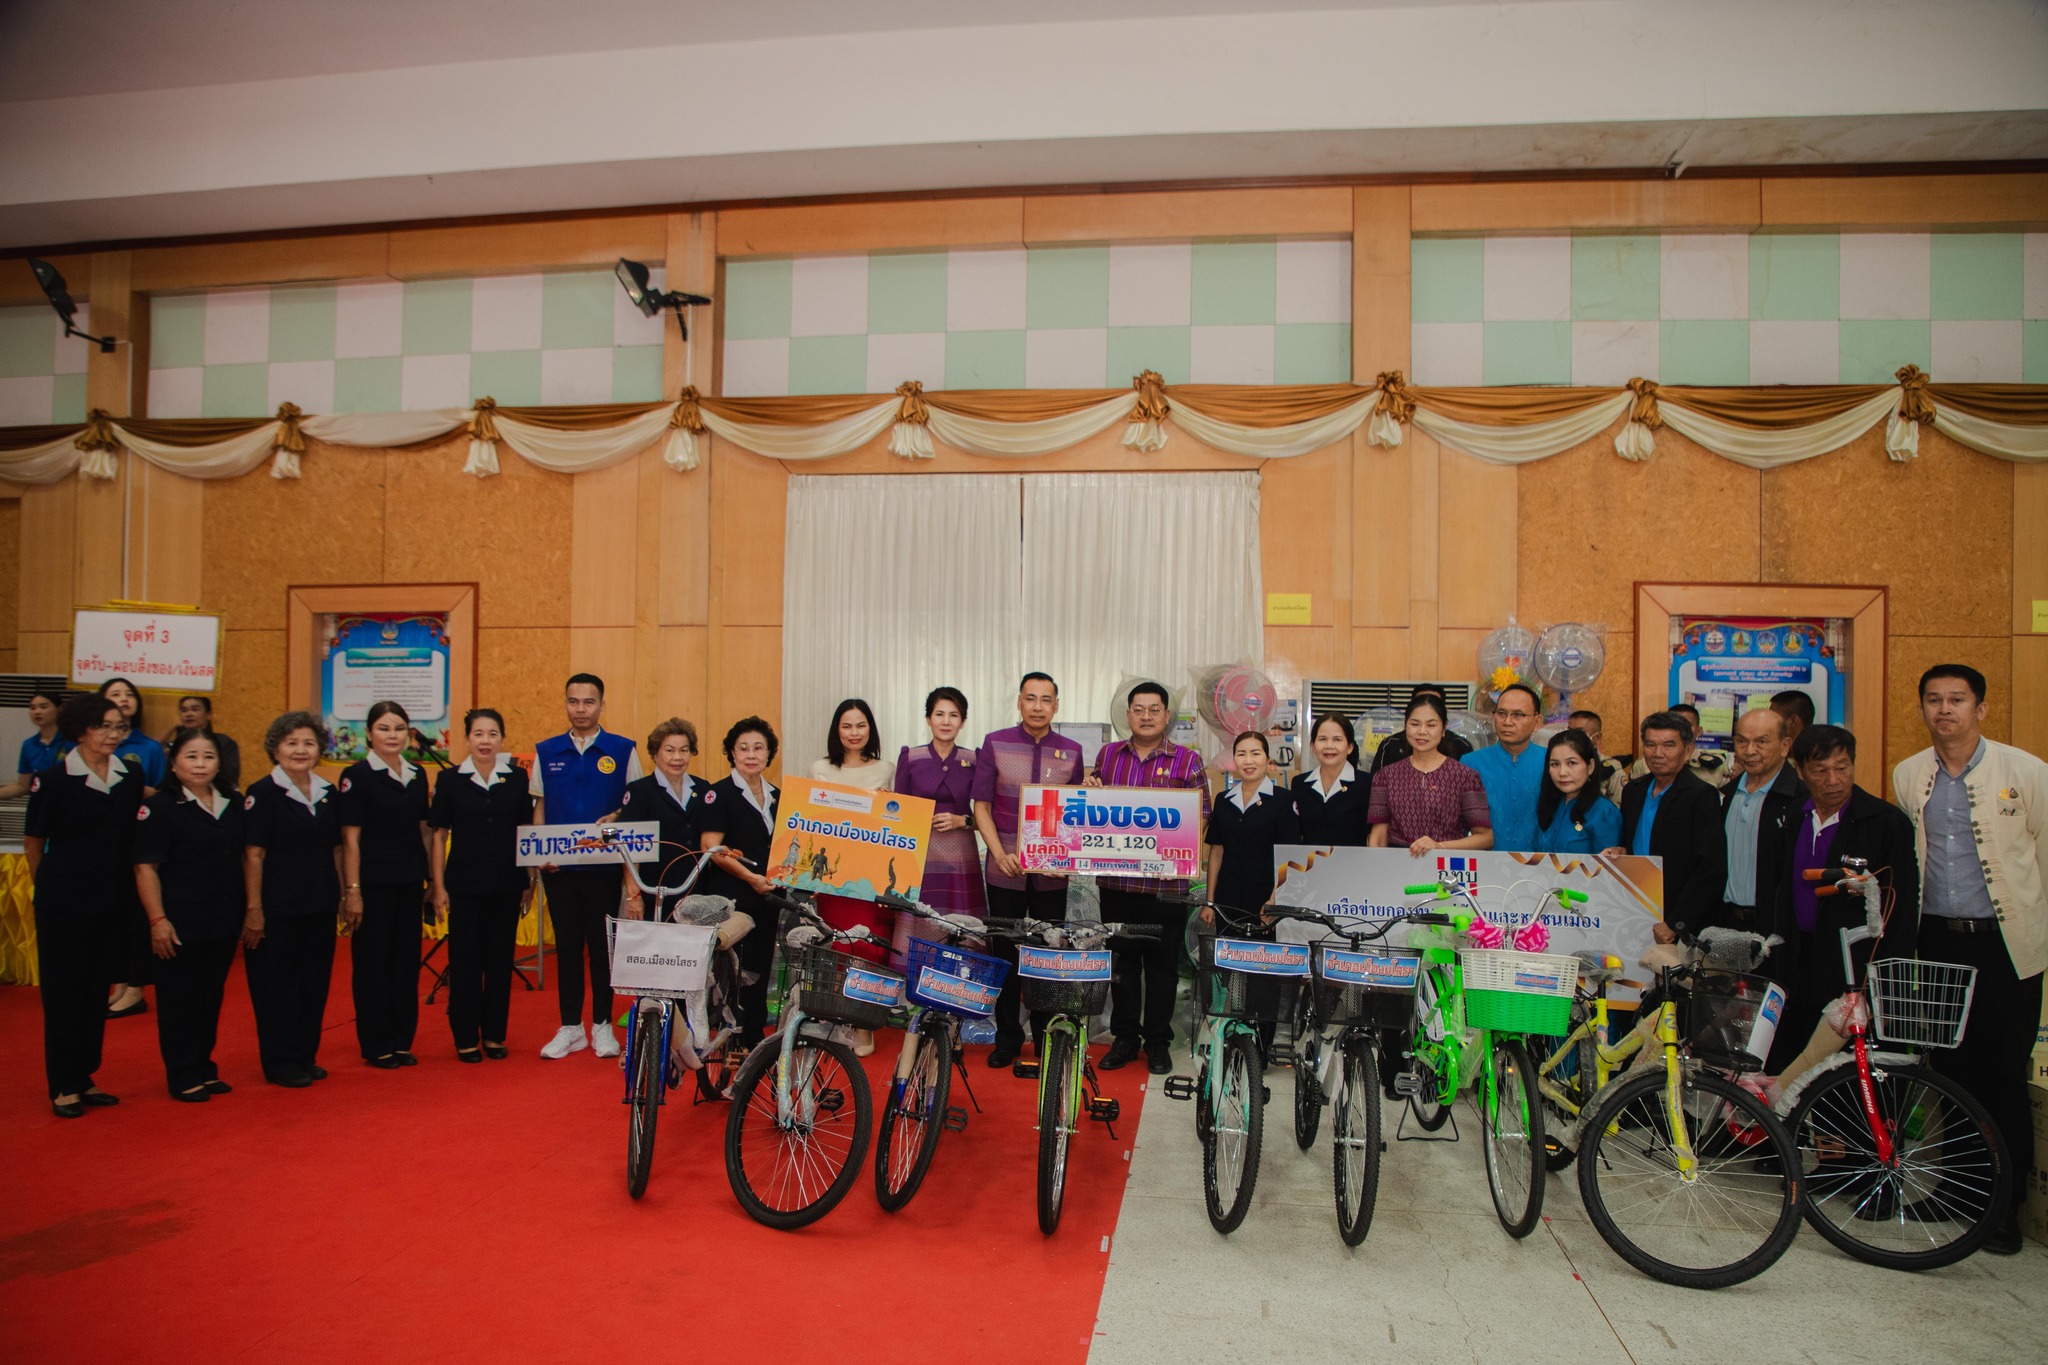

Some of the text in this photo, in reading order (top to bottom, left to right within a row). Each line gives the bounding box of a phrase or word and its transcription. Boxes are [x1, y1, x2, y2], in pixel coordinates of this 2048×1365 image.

[123, 619, 170, 648] จุดที่ 3
[1062, 790, 1181, 829] สิ่งของ
[787, 812, 917, 850] อำเภอเมืองยโสธร
[1026, 841, 1066, 859] มูลค่า
[1163, 847, 1193, 860] บาท
[1050, 858, 1165, 872] วันที่ 14 กุมภาพันธ์ 2567
[1438, 870, 1477, 883] กทบ
[626, 954, 698, 968] สสอ.เมืองยโสธร
